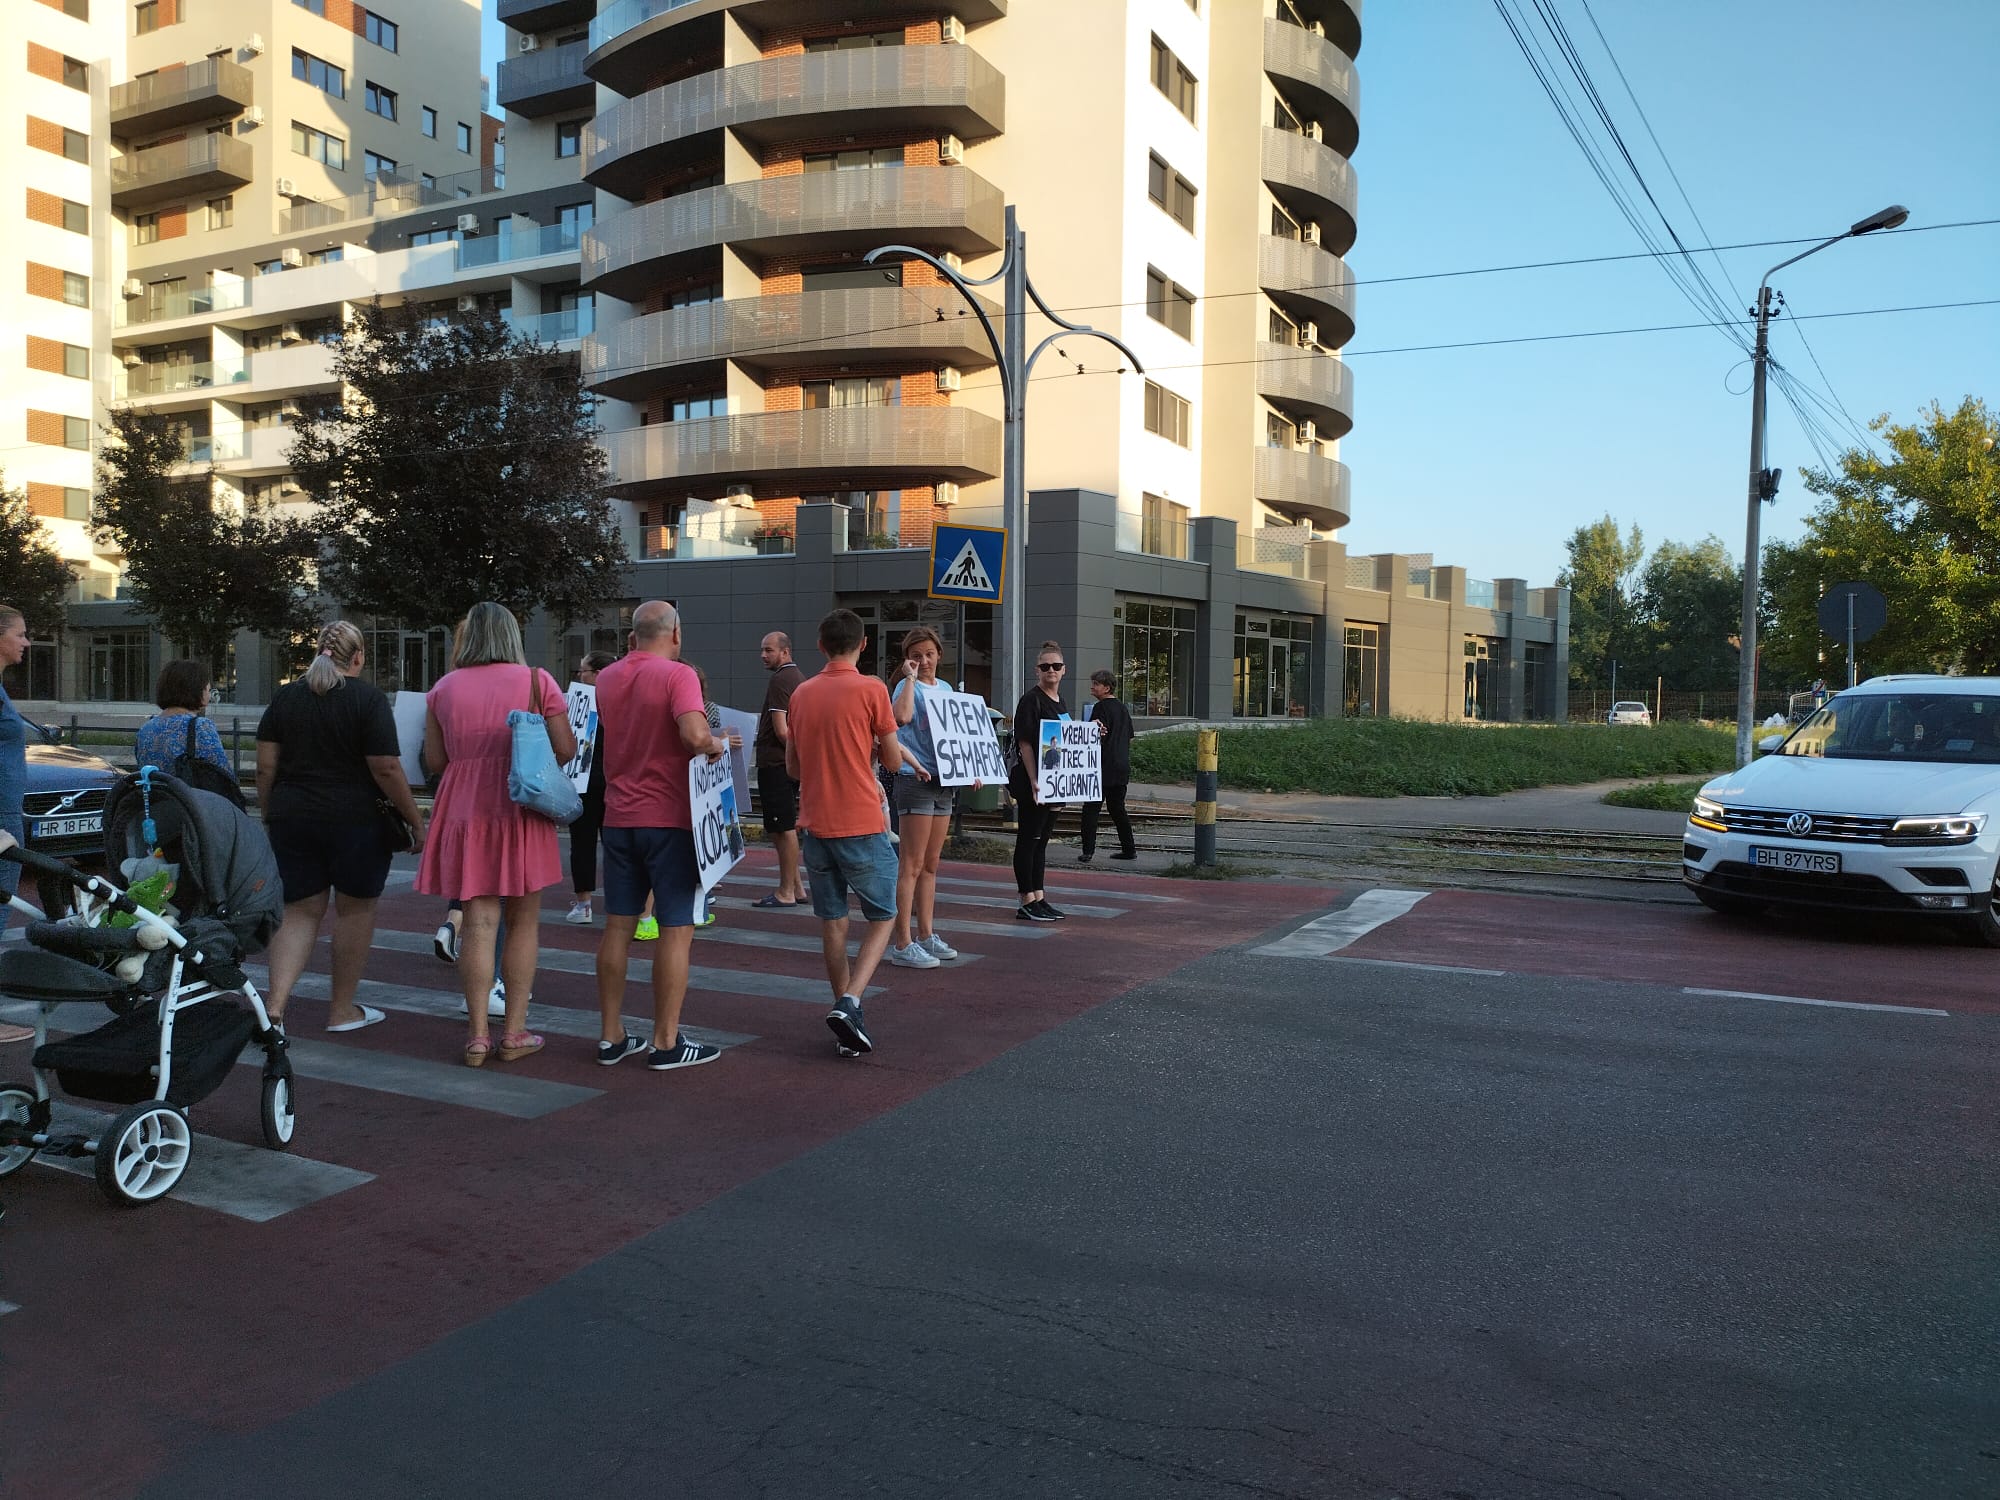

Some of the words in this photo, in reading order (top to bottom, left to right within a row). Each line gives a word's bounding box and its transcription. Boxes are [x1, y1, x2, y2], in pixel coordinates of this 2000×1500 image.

[929, 699, 995, 738] VREM
[1062, 725, 1089, 745] VREAU
[937, 738, 1008, 780] SEMAFOR
[1061, 748, 1084, 769] TREC
[1087, 746, 1098, 769] ÎN
[40, 822, 59, 836] HR
[63, 820, 76, 833] 18
[694, 801, 729, 871] UCIDE
[1757, 850, 1779, 865] BH
